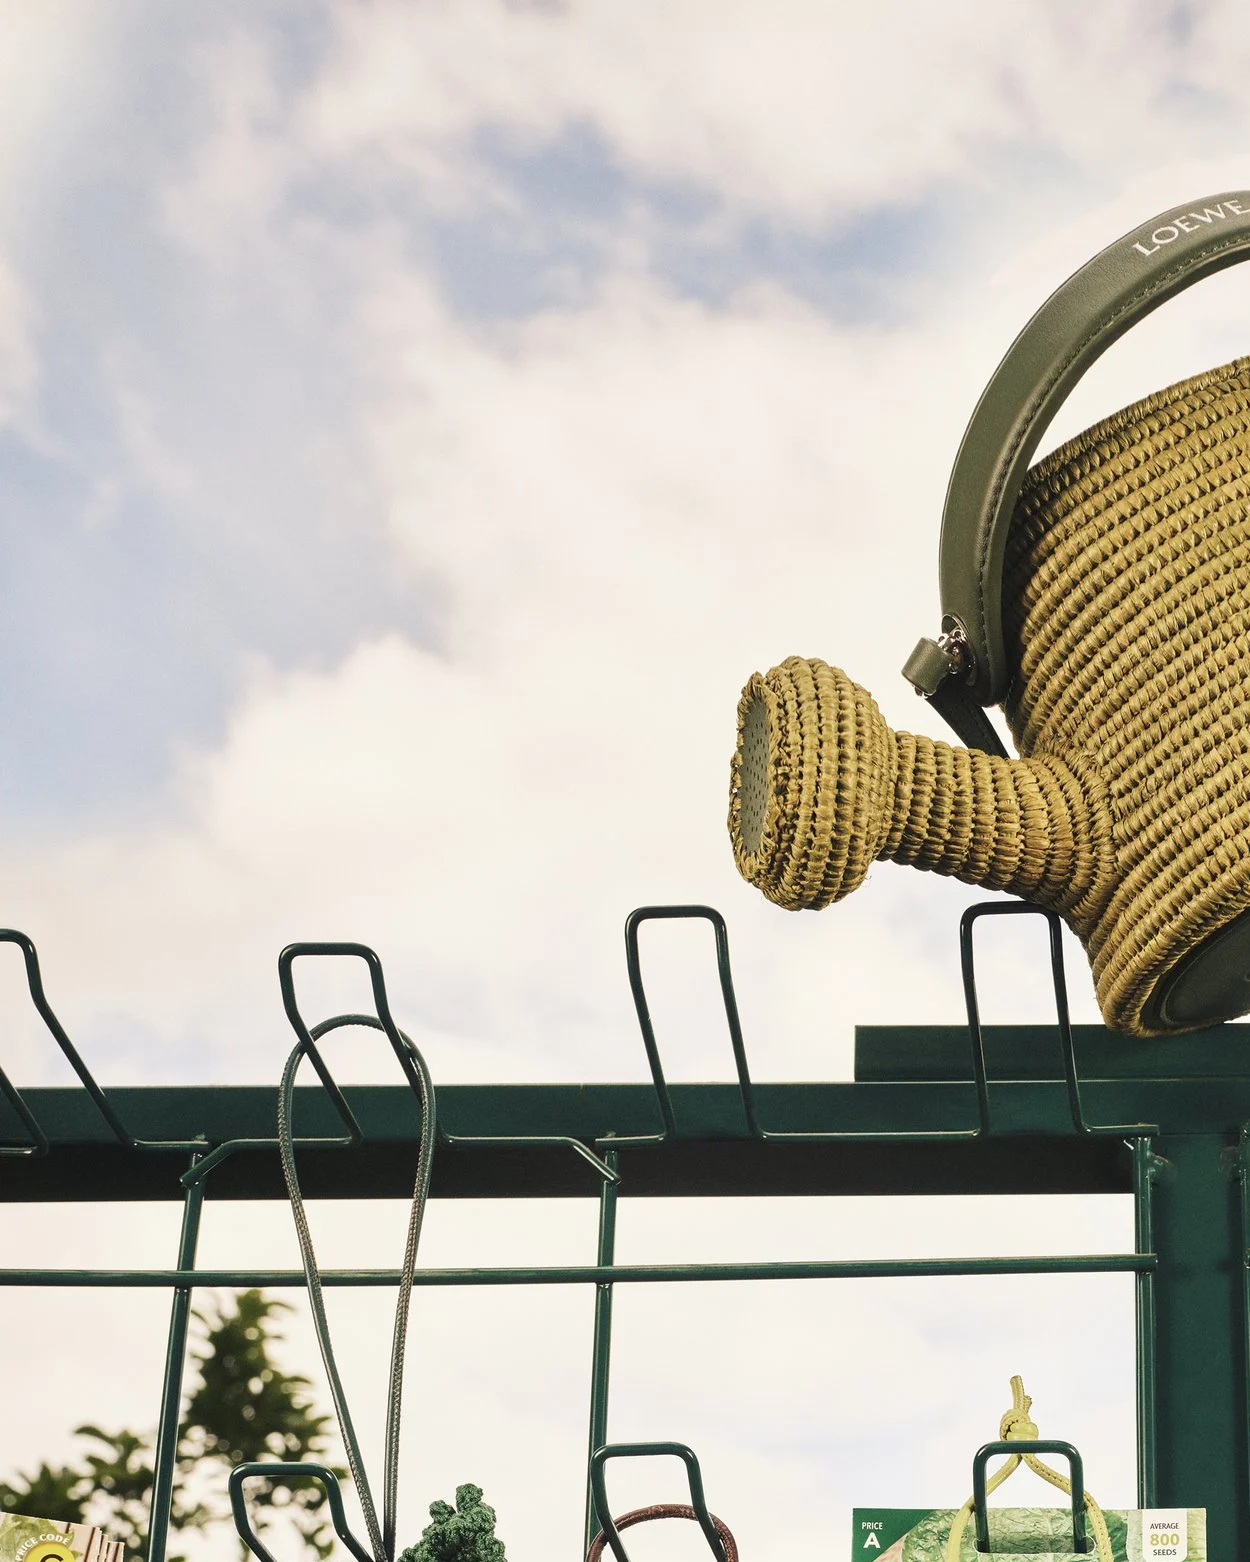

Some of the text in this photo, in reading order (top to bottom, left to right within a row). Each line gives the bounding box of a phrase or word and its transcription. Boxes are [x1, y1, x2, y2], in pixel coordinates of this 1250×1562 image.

[861, 1521, 883, 1530] PRICE
[1150, 1522, 1180, 1531] AVERAGE
[863, 1532, 881, 1549] A
[1150, 1533, 1180, 1547] 800
[15, 1533, 71, 1561] PRICE CODE
[1153, 1548, 1177, 1556] SEEDS
